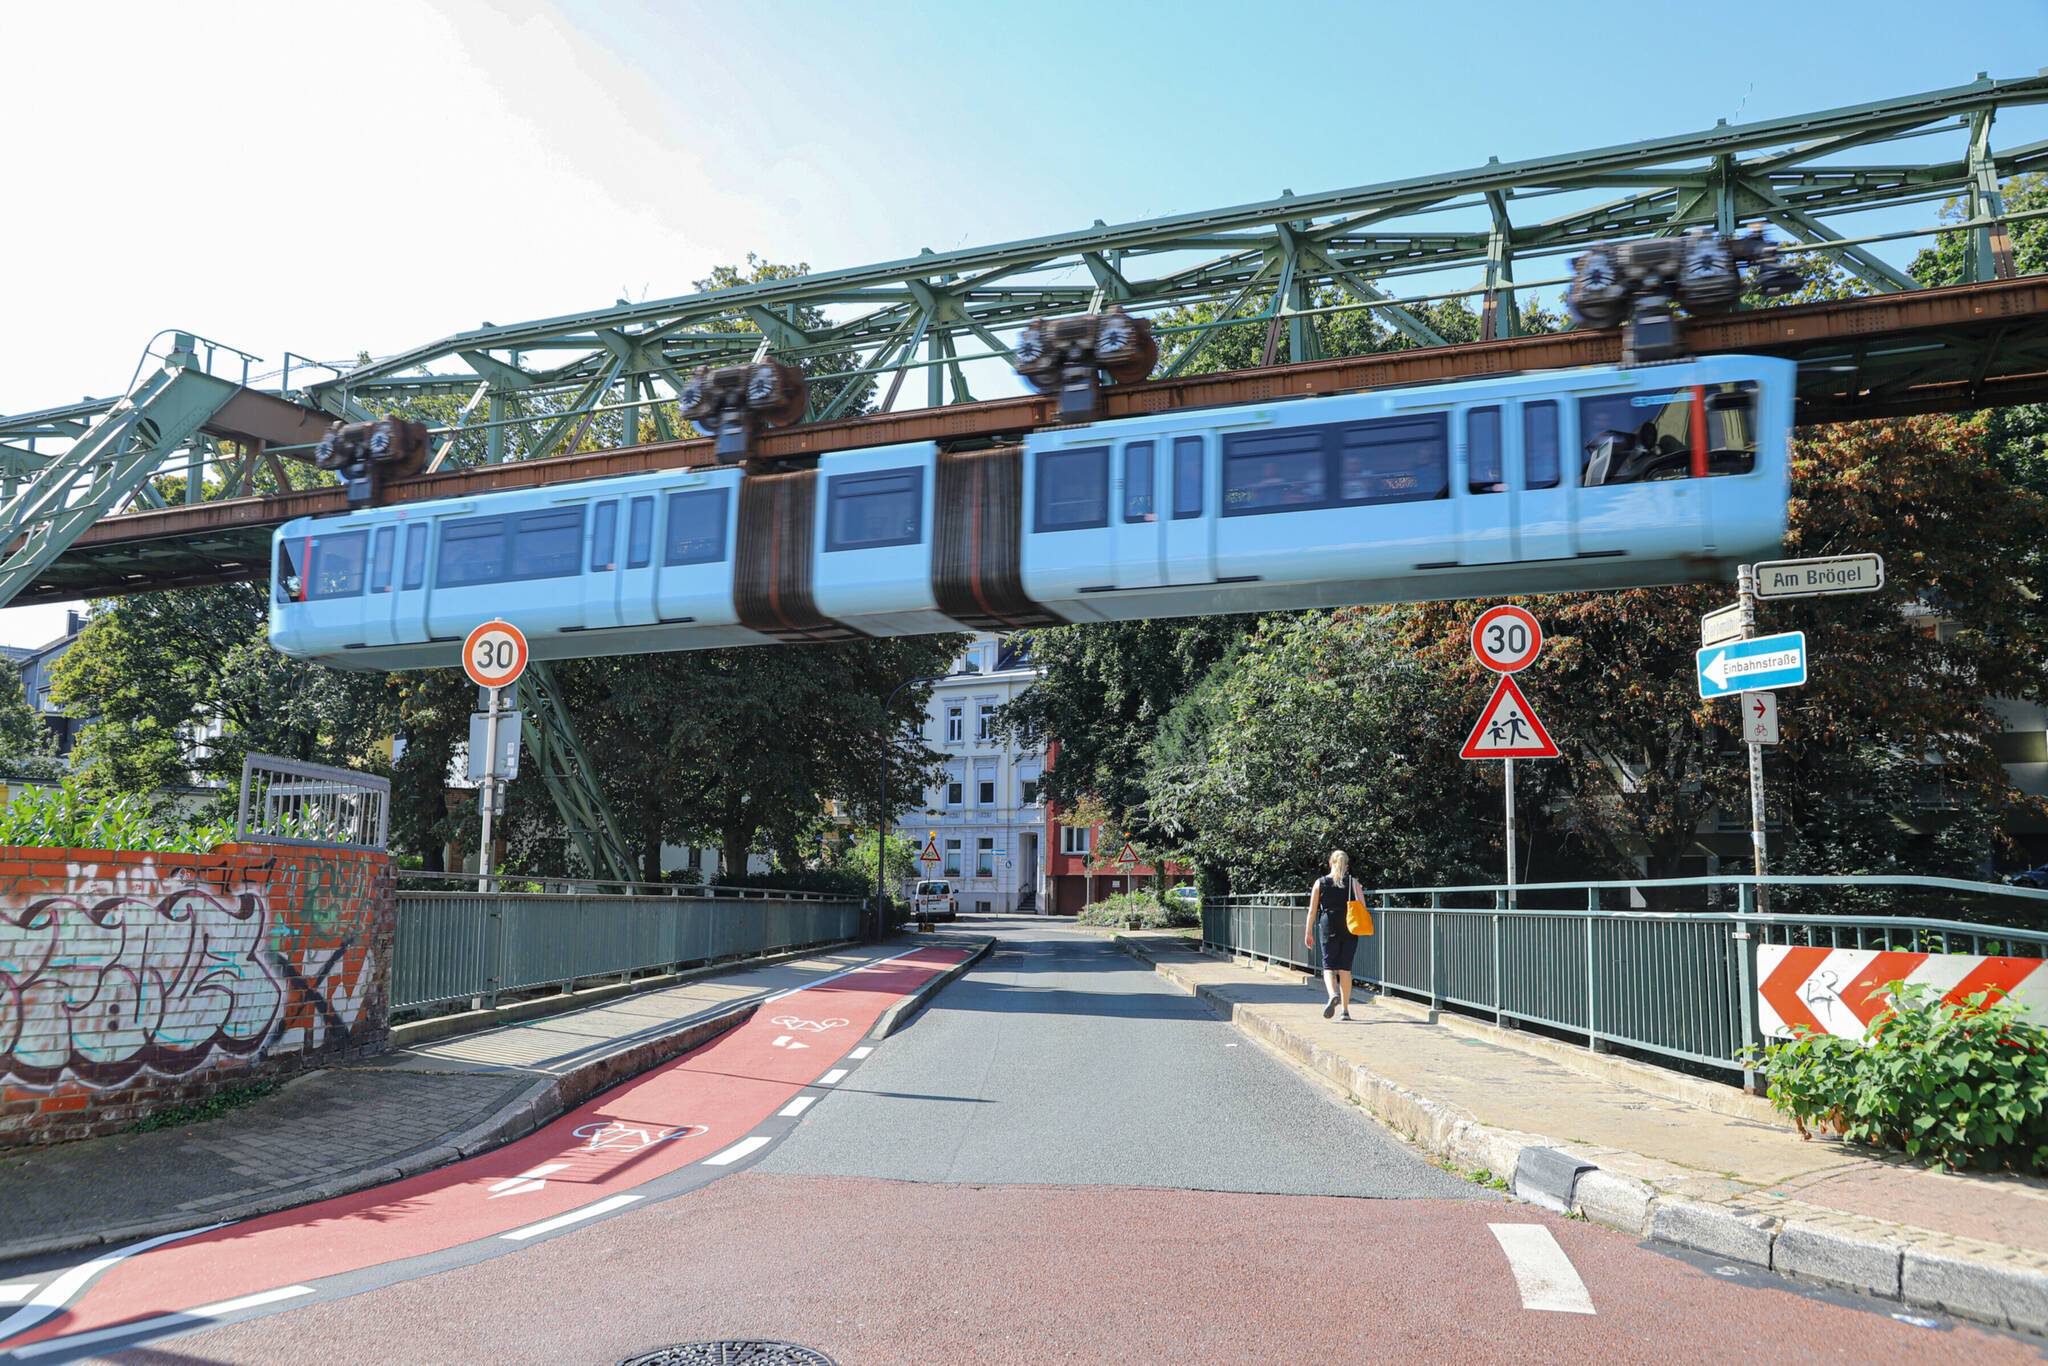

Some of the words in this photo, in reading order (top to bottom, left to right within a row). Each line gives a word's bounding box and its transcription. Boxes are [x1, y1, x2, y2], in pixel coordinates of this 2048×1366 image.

[1774, 573, 1798, 587] Am
[1807, 566, 1861, 585] Brögel
[1488, 625, 1525, 653] 30
[477, 640, 513, 669] 30
[1724, 654, 1796, 674] Einbahnstraße
